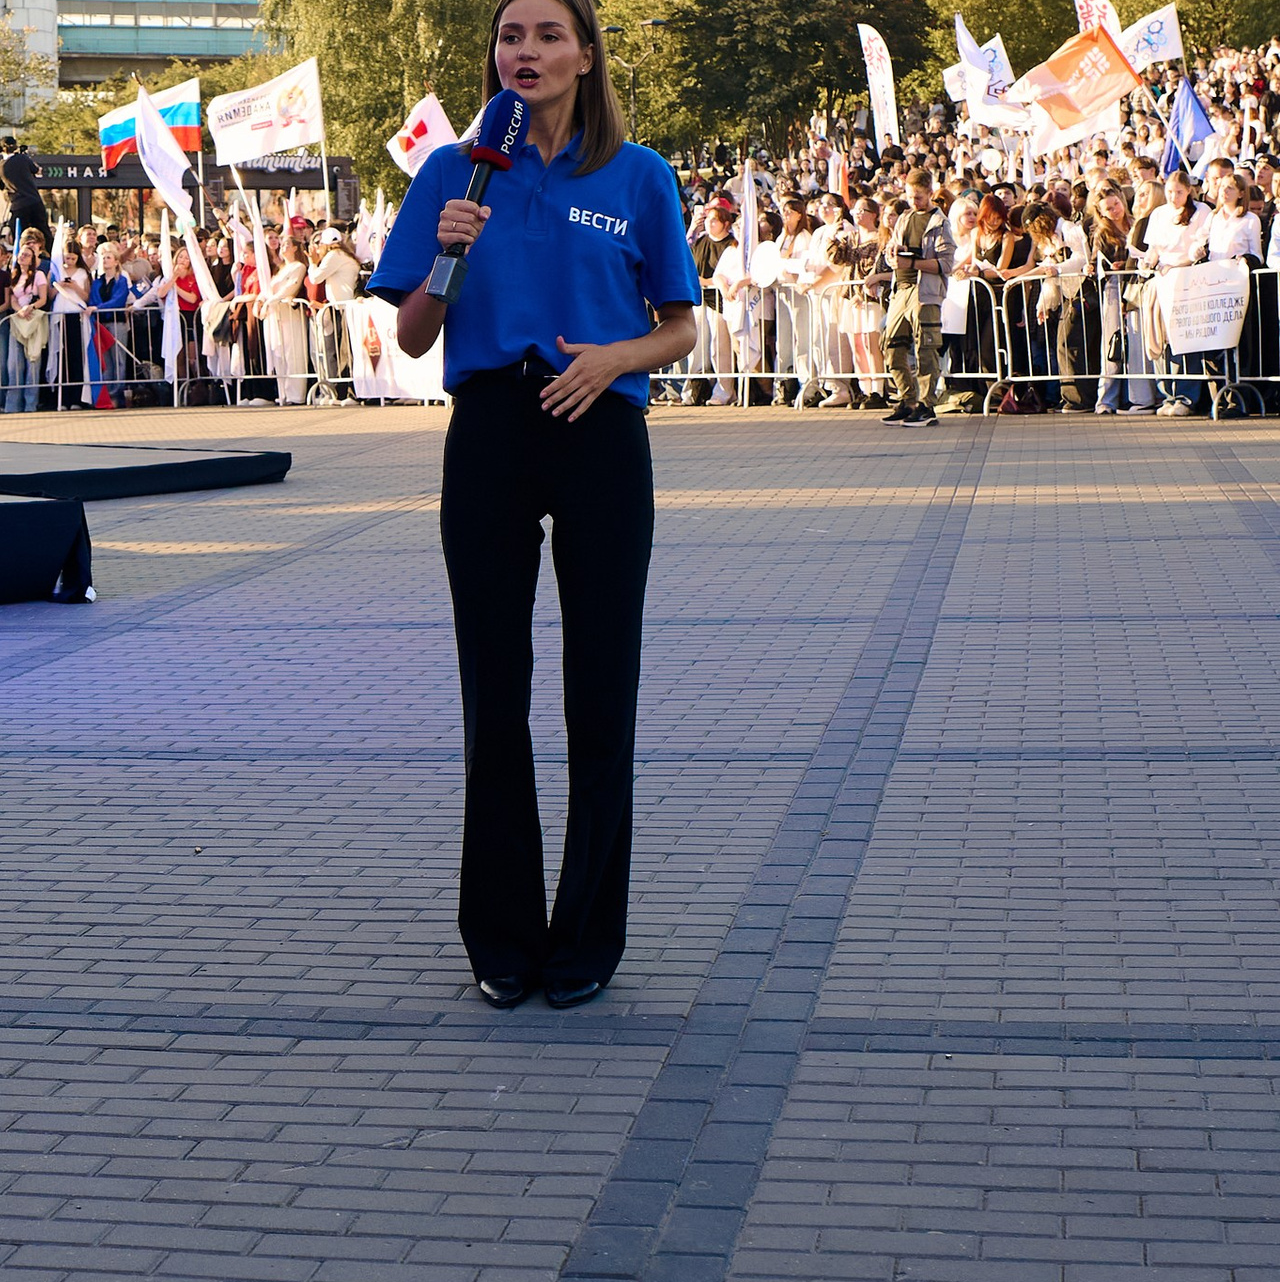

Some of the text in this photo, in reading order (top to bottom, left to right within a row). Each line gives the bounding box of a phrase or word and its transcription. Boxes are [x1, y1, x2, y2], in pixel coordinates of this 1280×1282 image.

[500, 100, 524, 155] РОССИЯ
[568, 206, 628, 236] ВЕСТИ
[1223, 310, 1243, 323] ДЕЛА
